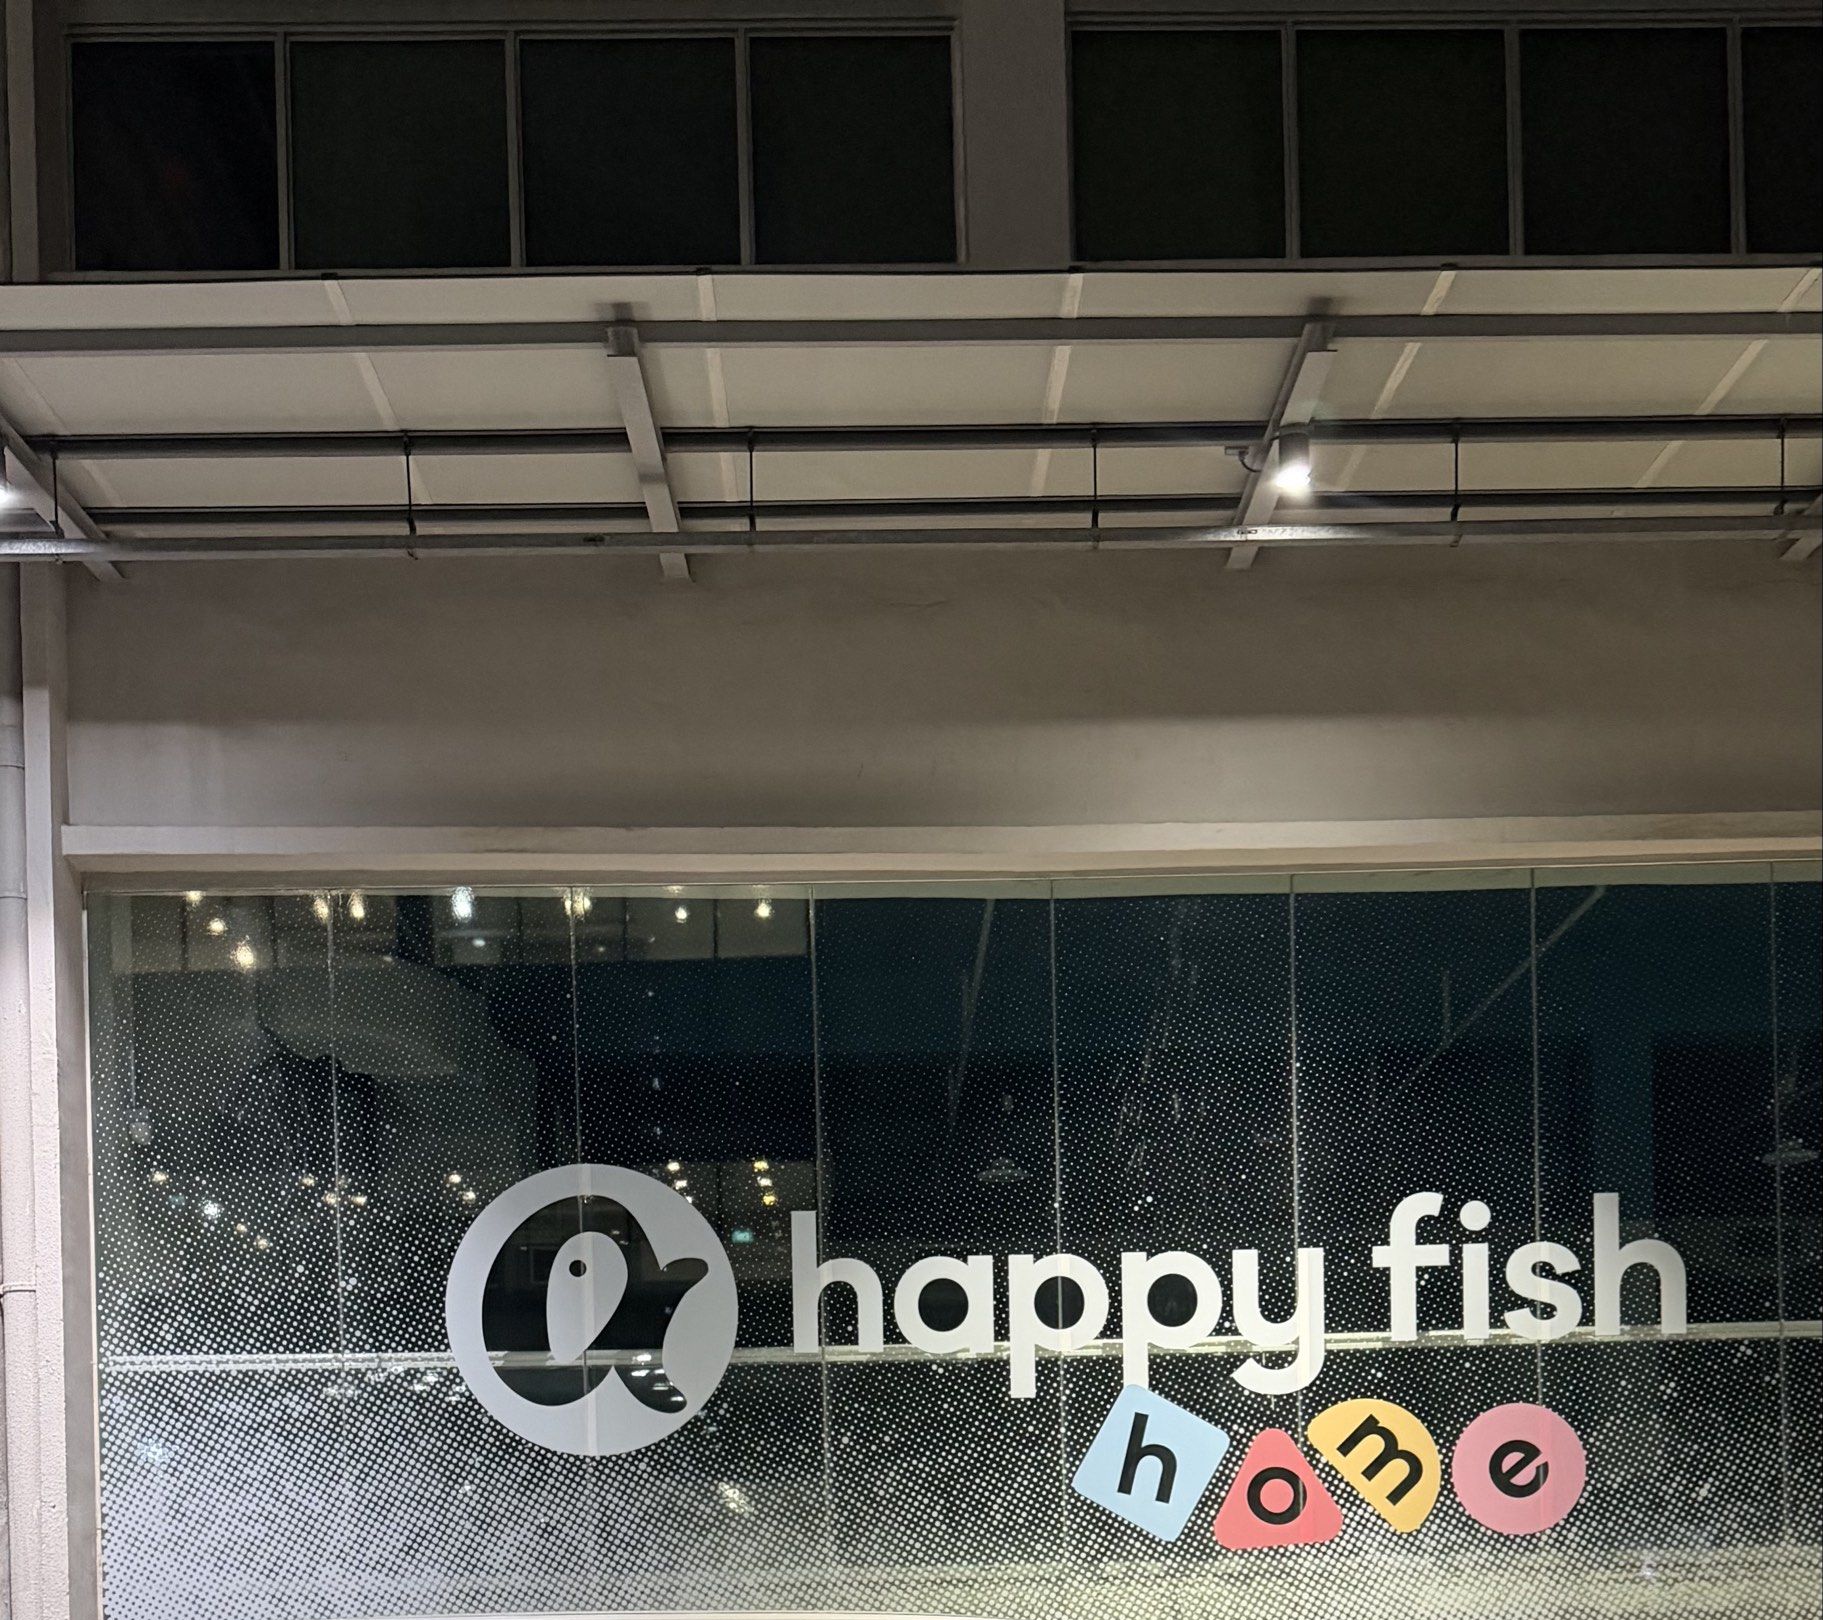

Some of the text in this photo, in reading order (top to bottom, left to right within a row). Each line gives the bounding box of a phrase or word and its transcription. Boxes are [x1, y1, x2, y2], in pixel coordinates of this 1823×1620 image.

[791, 1191, 1688, 1399] happy fish
[1117, 1412, 1550, 1525] home
